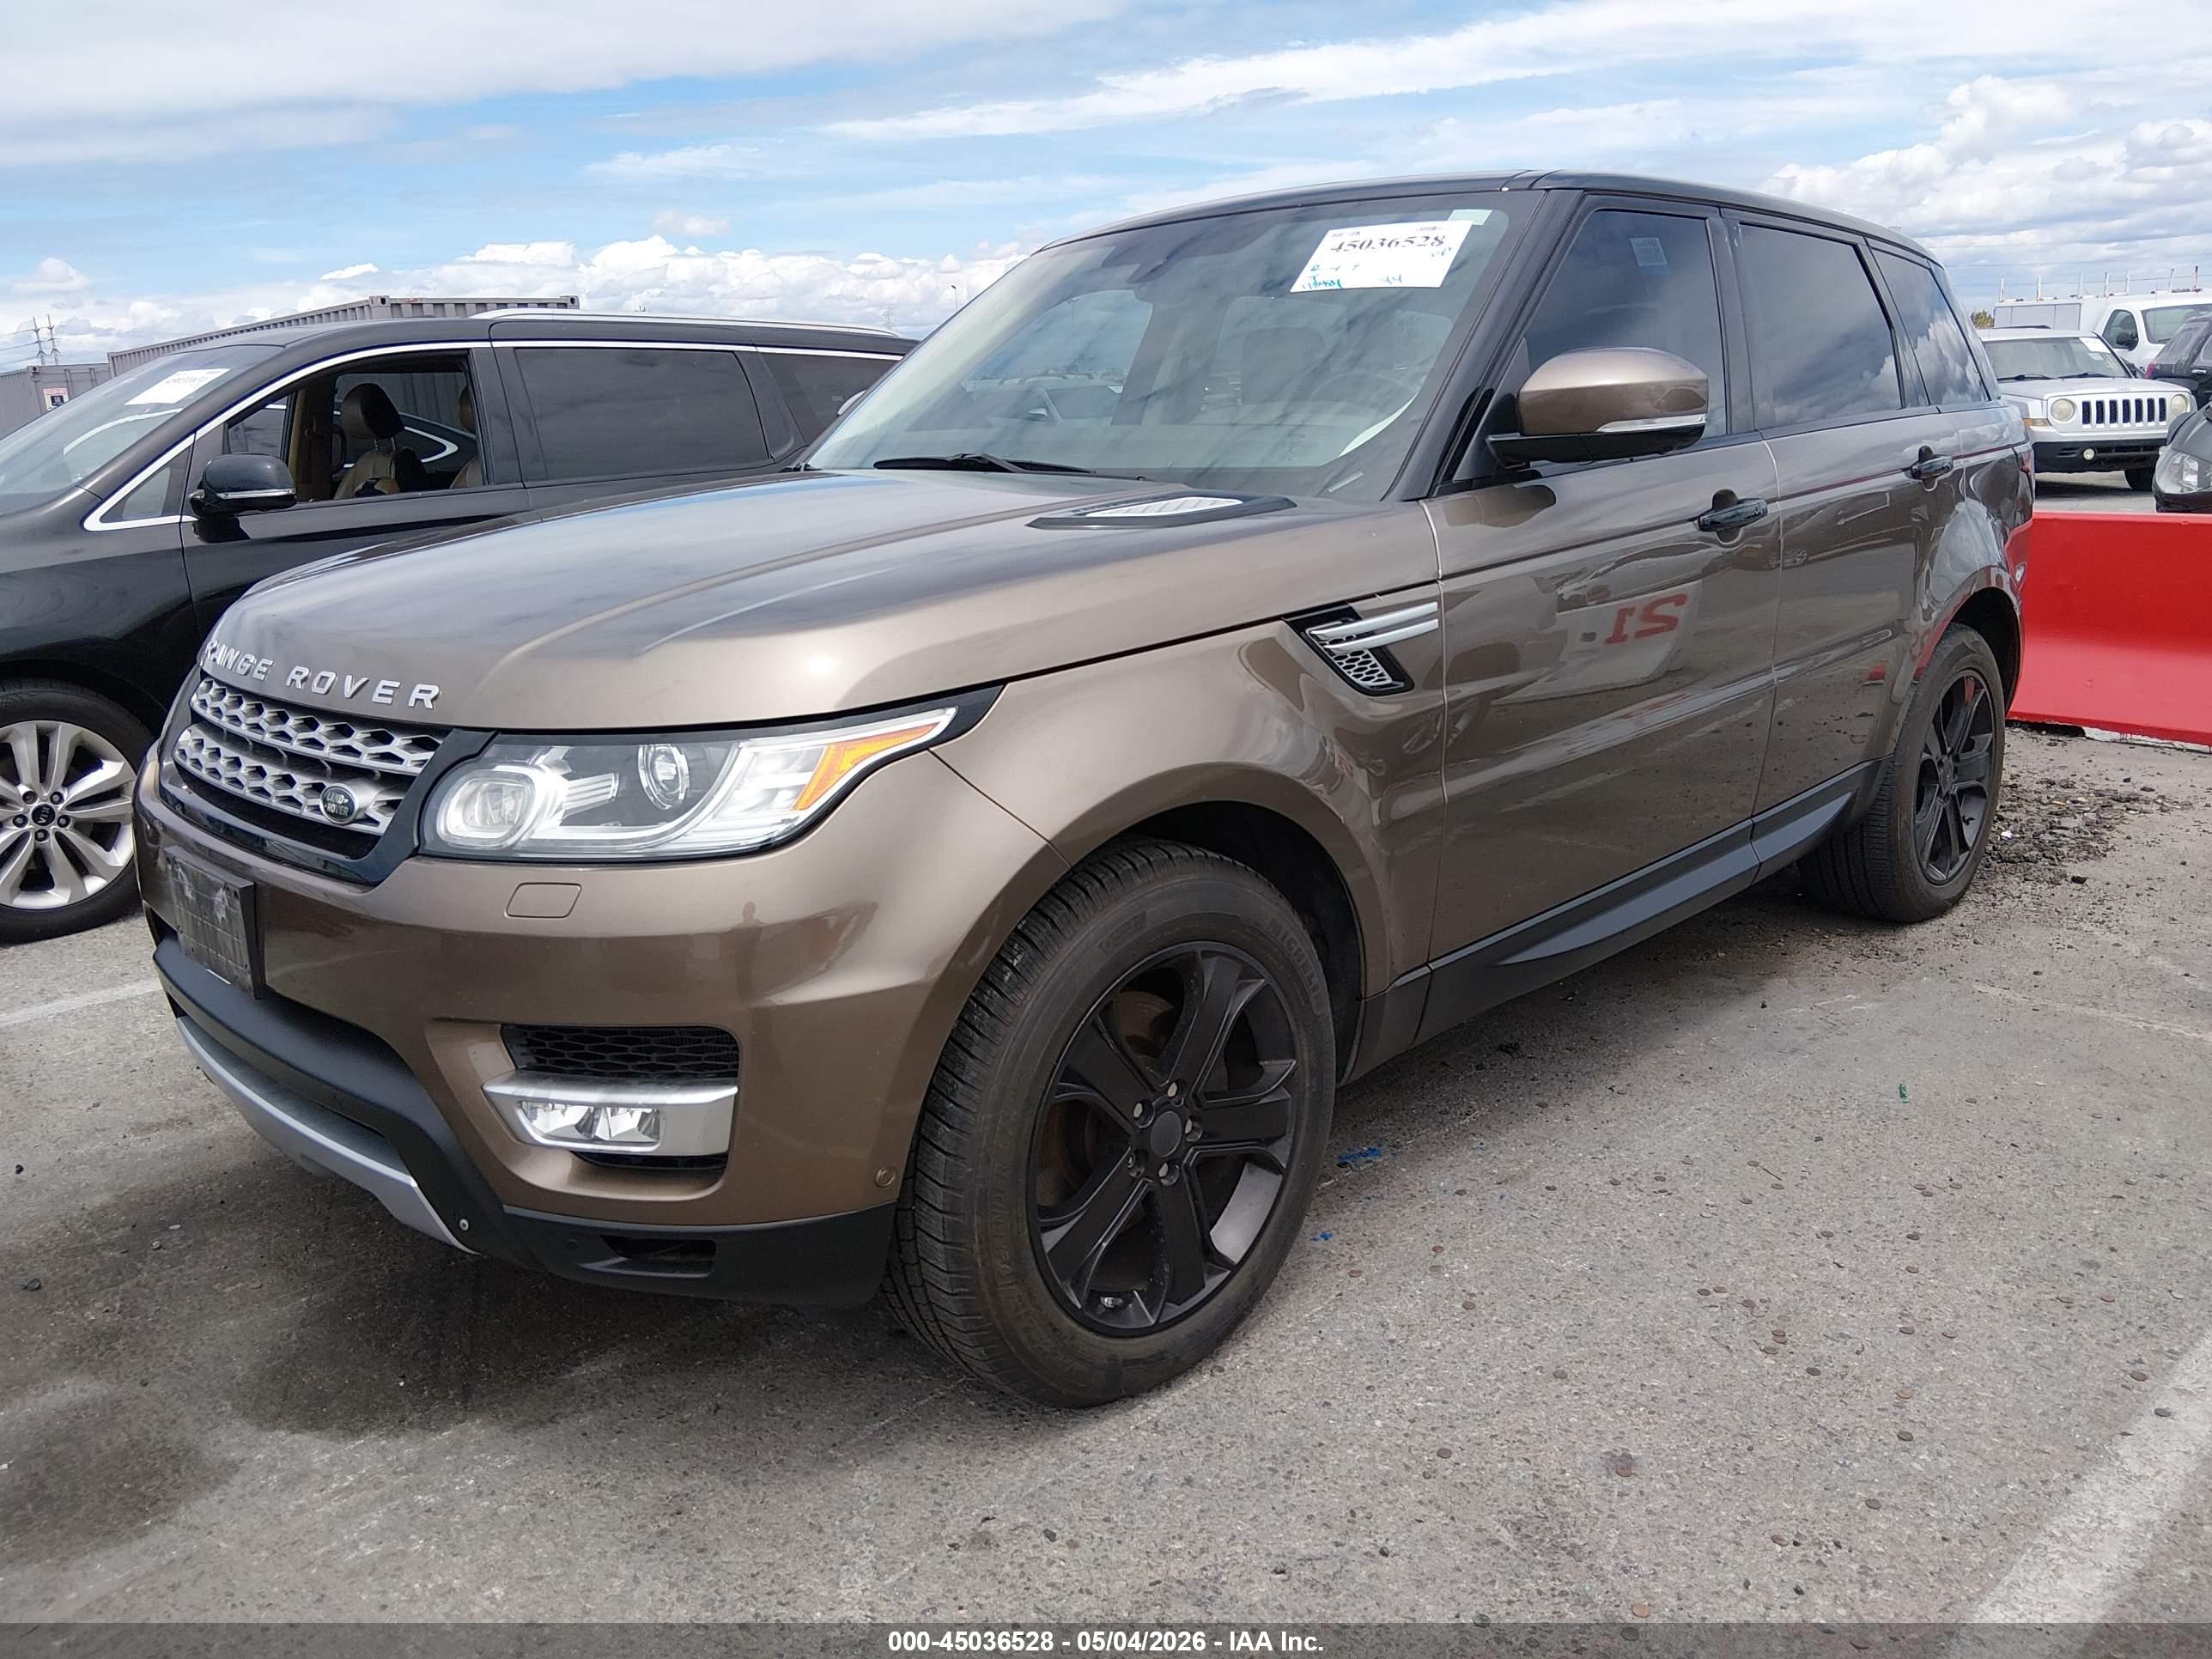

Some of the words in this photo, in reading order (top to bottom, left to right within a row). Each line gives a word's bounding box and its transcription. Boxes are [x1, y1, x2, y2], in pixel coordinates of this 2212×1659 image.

[1330, 235, 1445, 252] 45036528
[200, 640, 274, 681] RANGE
[285, 665, 441, 709] ROVER
[327, 791, 345, 803] LAND
[326, 804, 349, 817] ROVER
